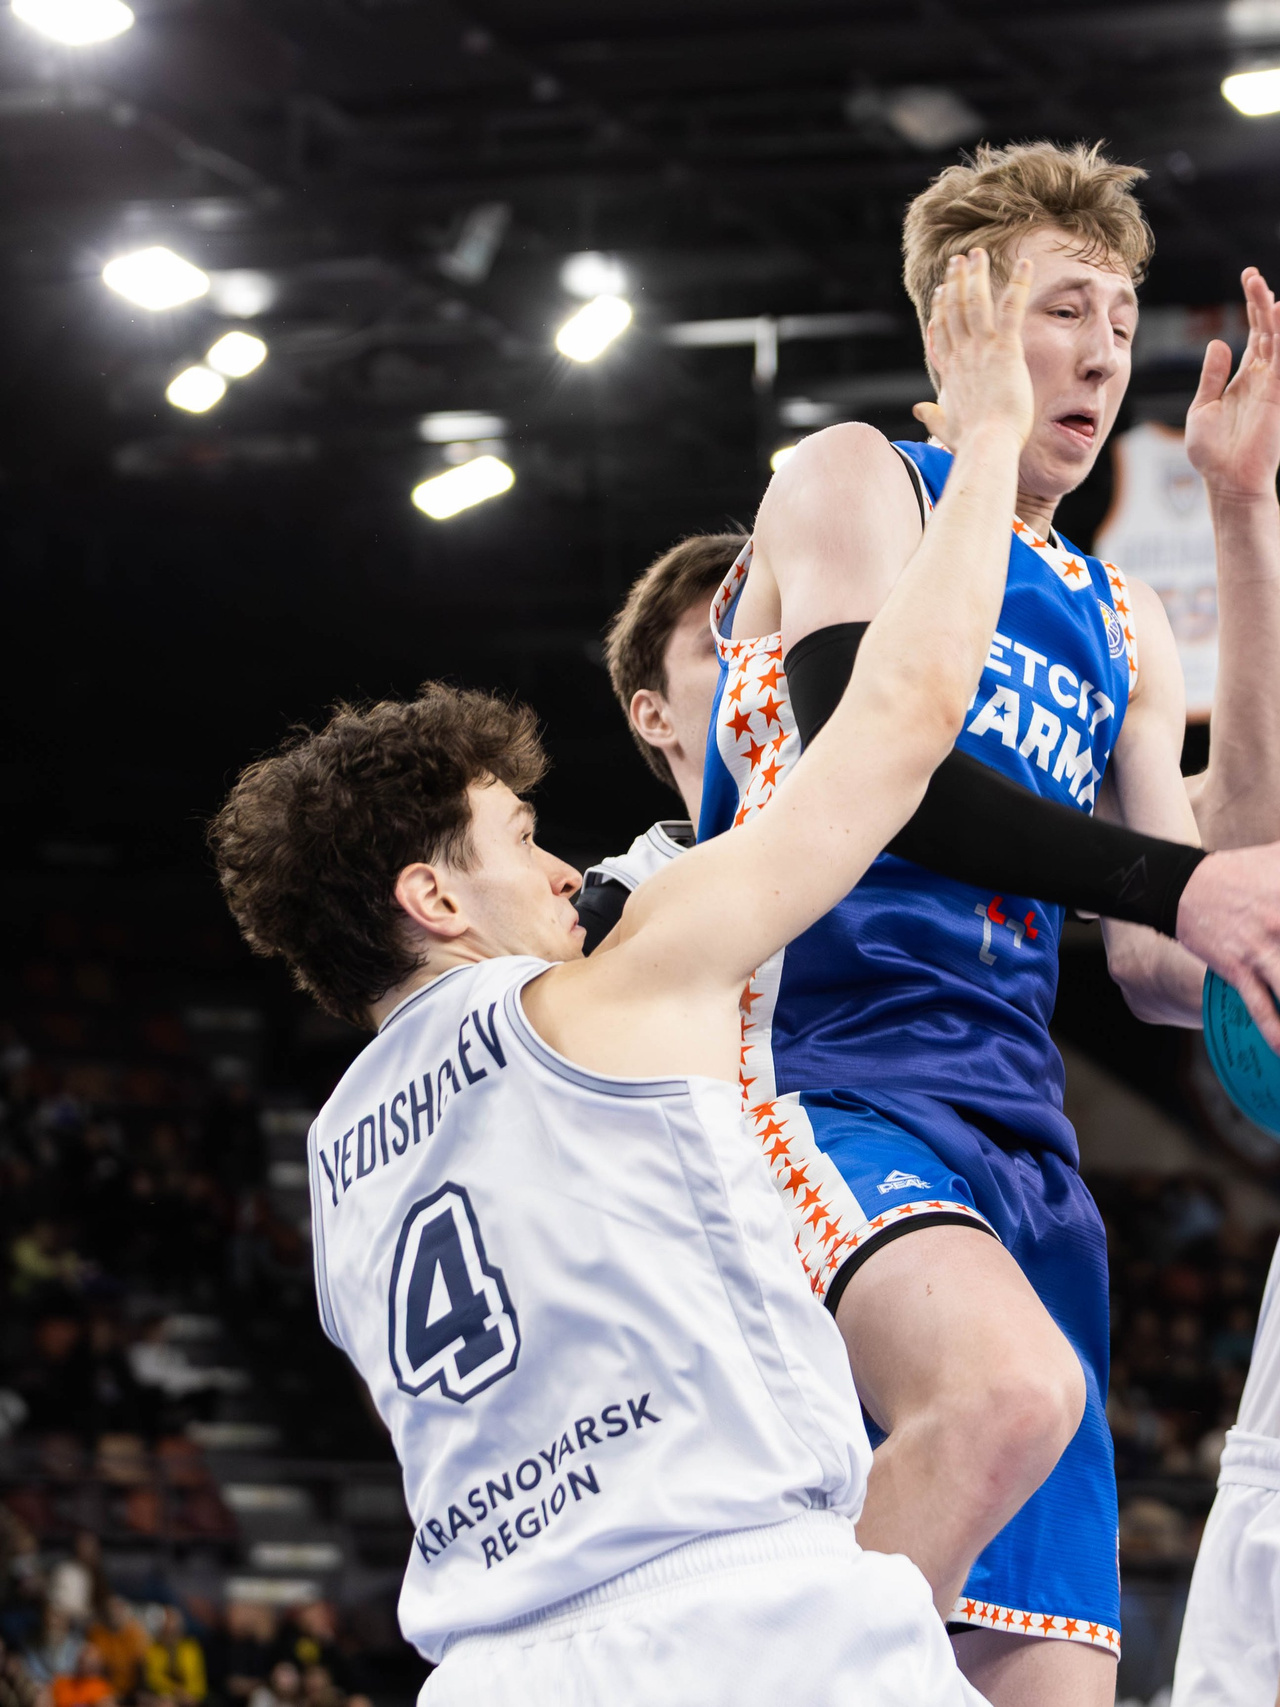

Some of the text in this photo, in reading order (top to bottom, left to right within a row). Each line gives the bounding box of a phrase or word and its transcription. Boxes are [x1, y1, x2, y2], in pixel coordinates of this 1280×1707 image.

[876, 1179, 934, 1195] PEAK
[388, 1180, 521, 1404] 4
[416, 1392, 662, 1564] KRASNOYARSK
[481, 1464, 601, 1570] REGION
